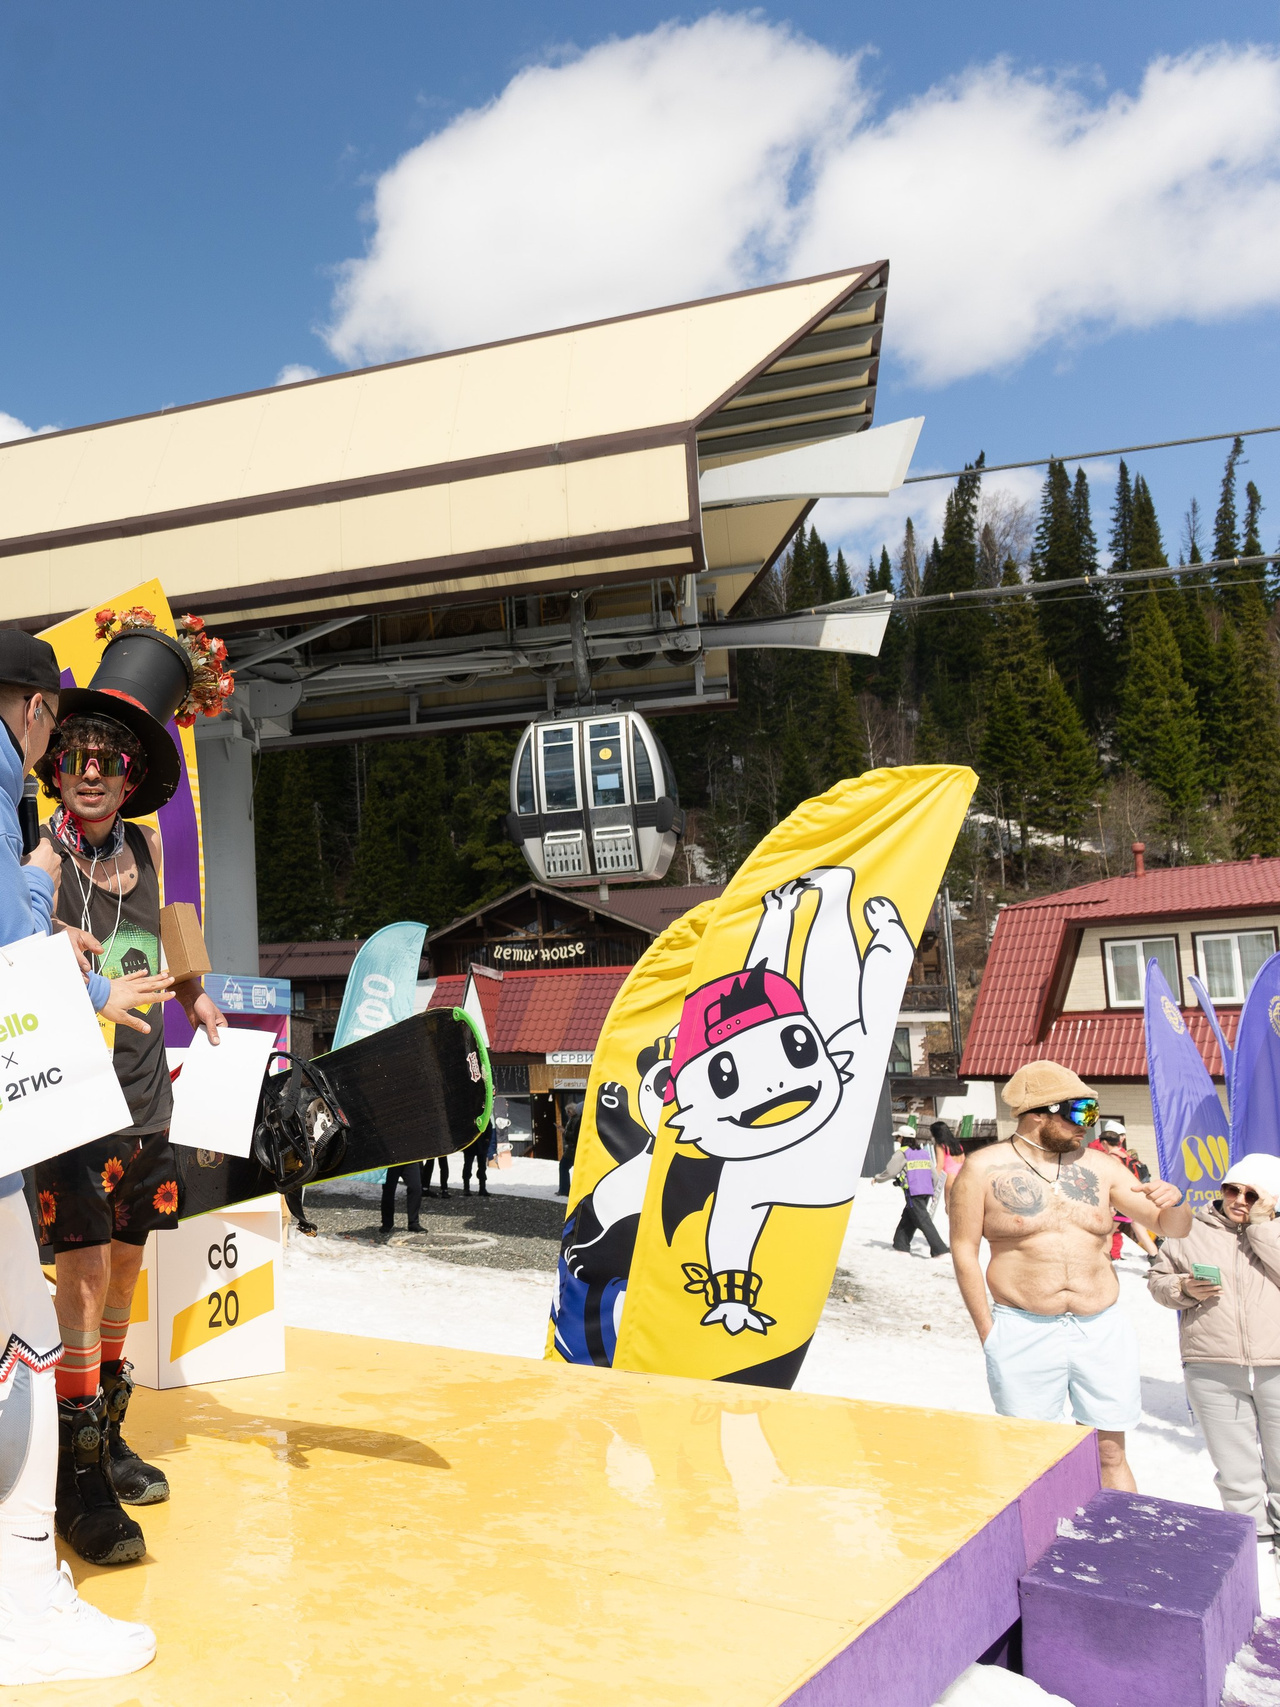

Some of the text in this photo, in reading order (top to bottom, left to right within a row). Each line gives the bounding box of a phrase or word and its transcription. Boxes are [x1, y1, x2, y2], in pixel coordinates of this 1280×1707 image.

[5, 1067, 63, 1102] 2ГИС
[207, 1232, 238, 1271] сб
[207, 1290, 240, 1329] 20
